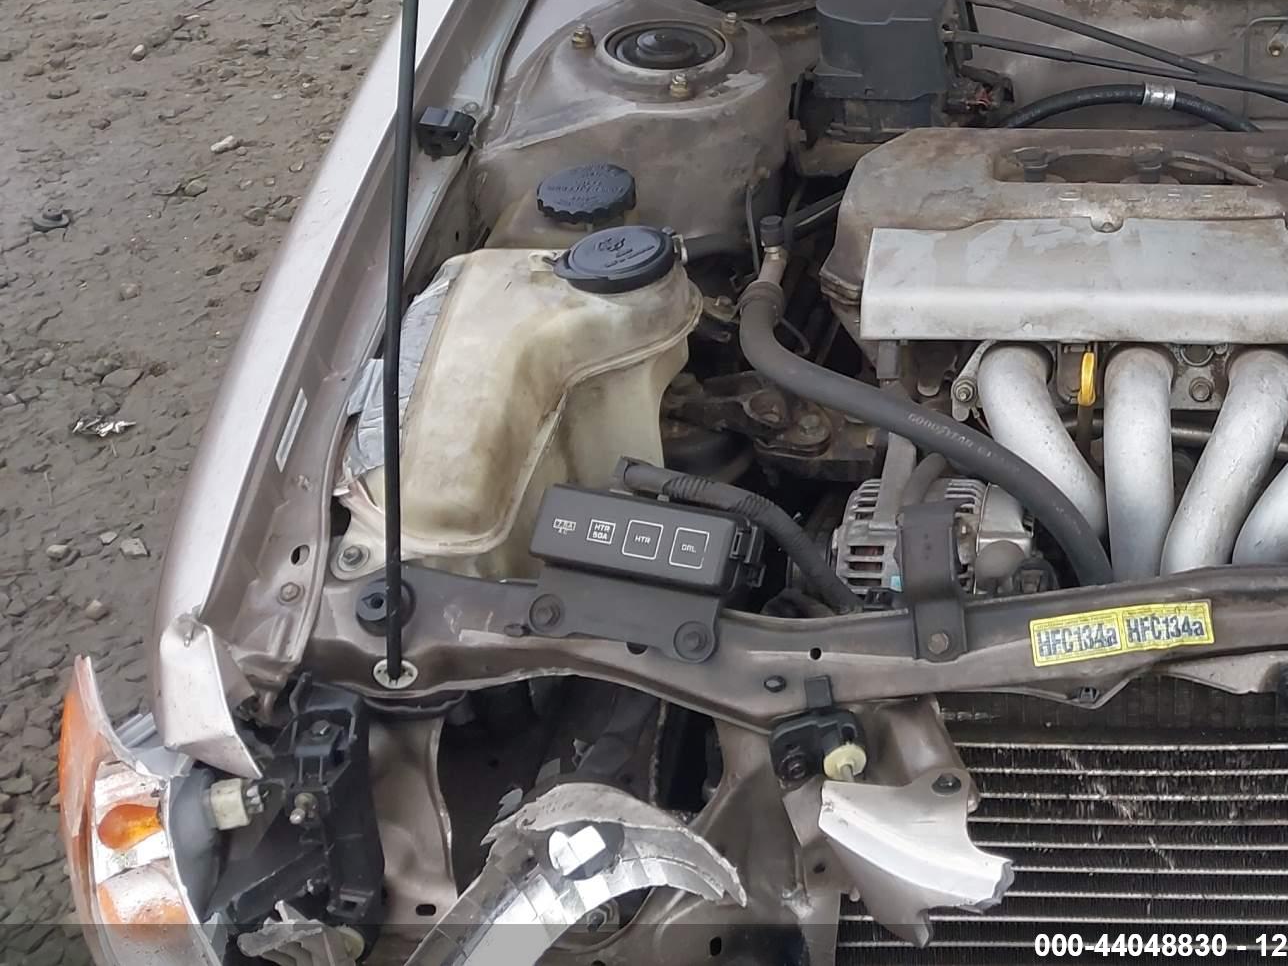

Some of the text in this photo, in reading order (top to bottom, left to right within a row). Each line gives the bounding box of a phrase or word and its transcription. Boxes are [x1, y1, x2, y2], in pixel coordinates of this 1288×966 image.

[594, 523, 611, 533] HTR
[634, 535, 651, 545] HTR
[1125, 612, 1206, 644] HFC134a
[1036, 623, 1119, 658] HFC134a
